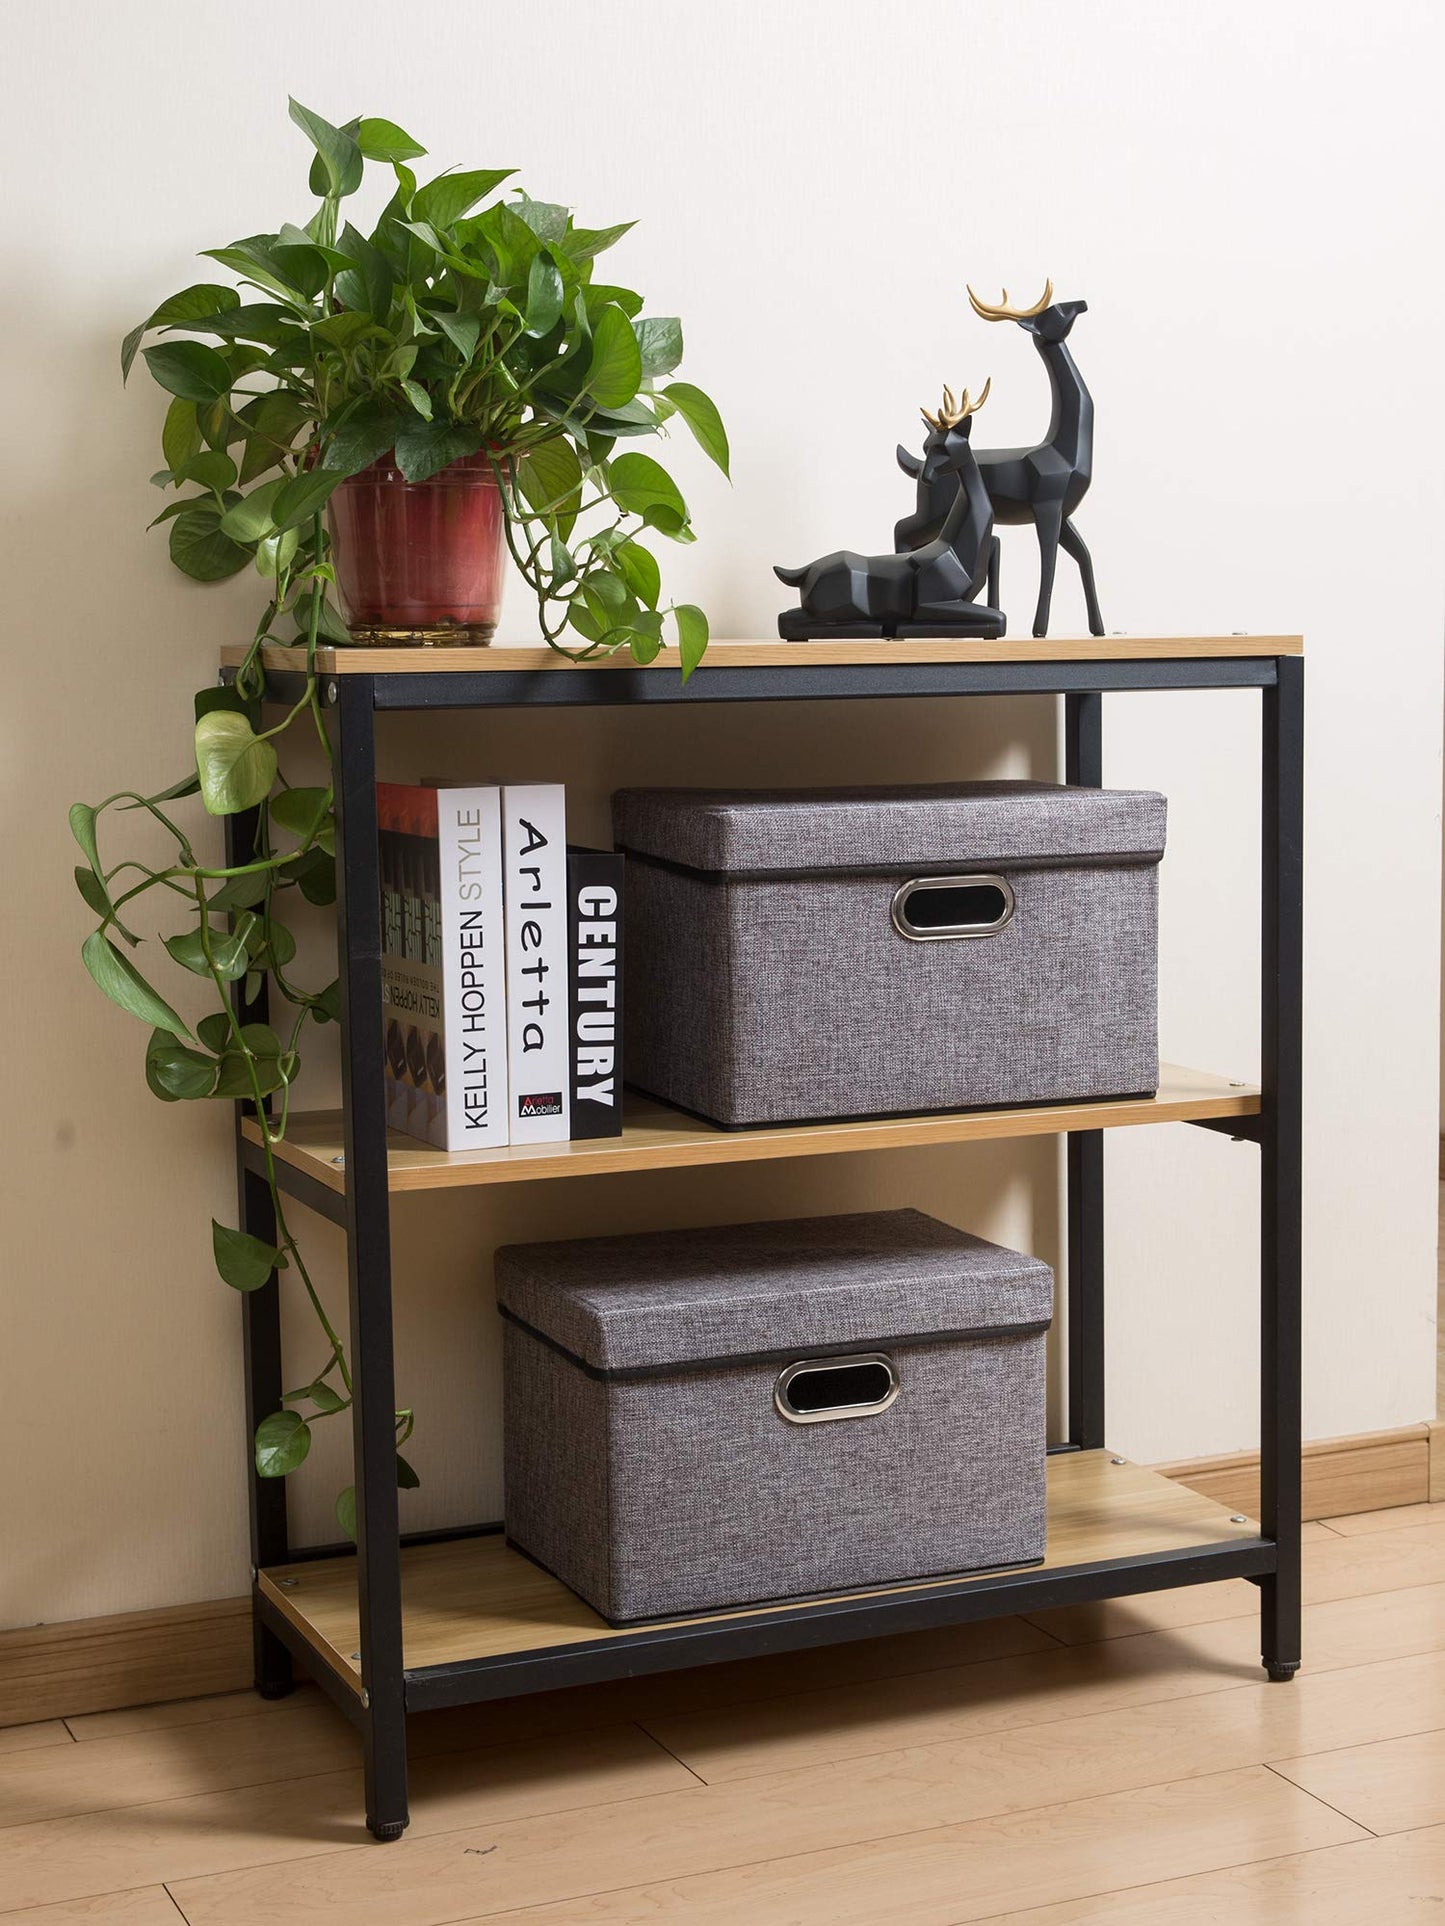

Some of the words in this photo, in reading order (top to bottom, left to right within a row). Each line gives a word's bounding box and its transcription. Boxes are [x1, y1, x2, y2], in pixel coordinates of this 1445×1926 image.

[457, 808, 483, 901] STYLE
[459, 910, 485, 1033] HOPPEN
[518, 817, 552, 1054] Arletta
[391, 986, 417, 1012] HOPPEN
[419, 995, 440, 1019] KELLY
[577, 885, 618, 1107] CENTURY
[463, 1041, 489, 1130] KELLY
